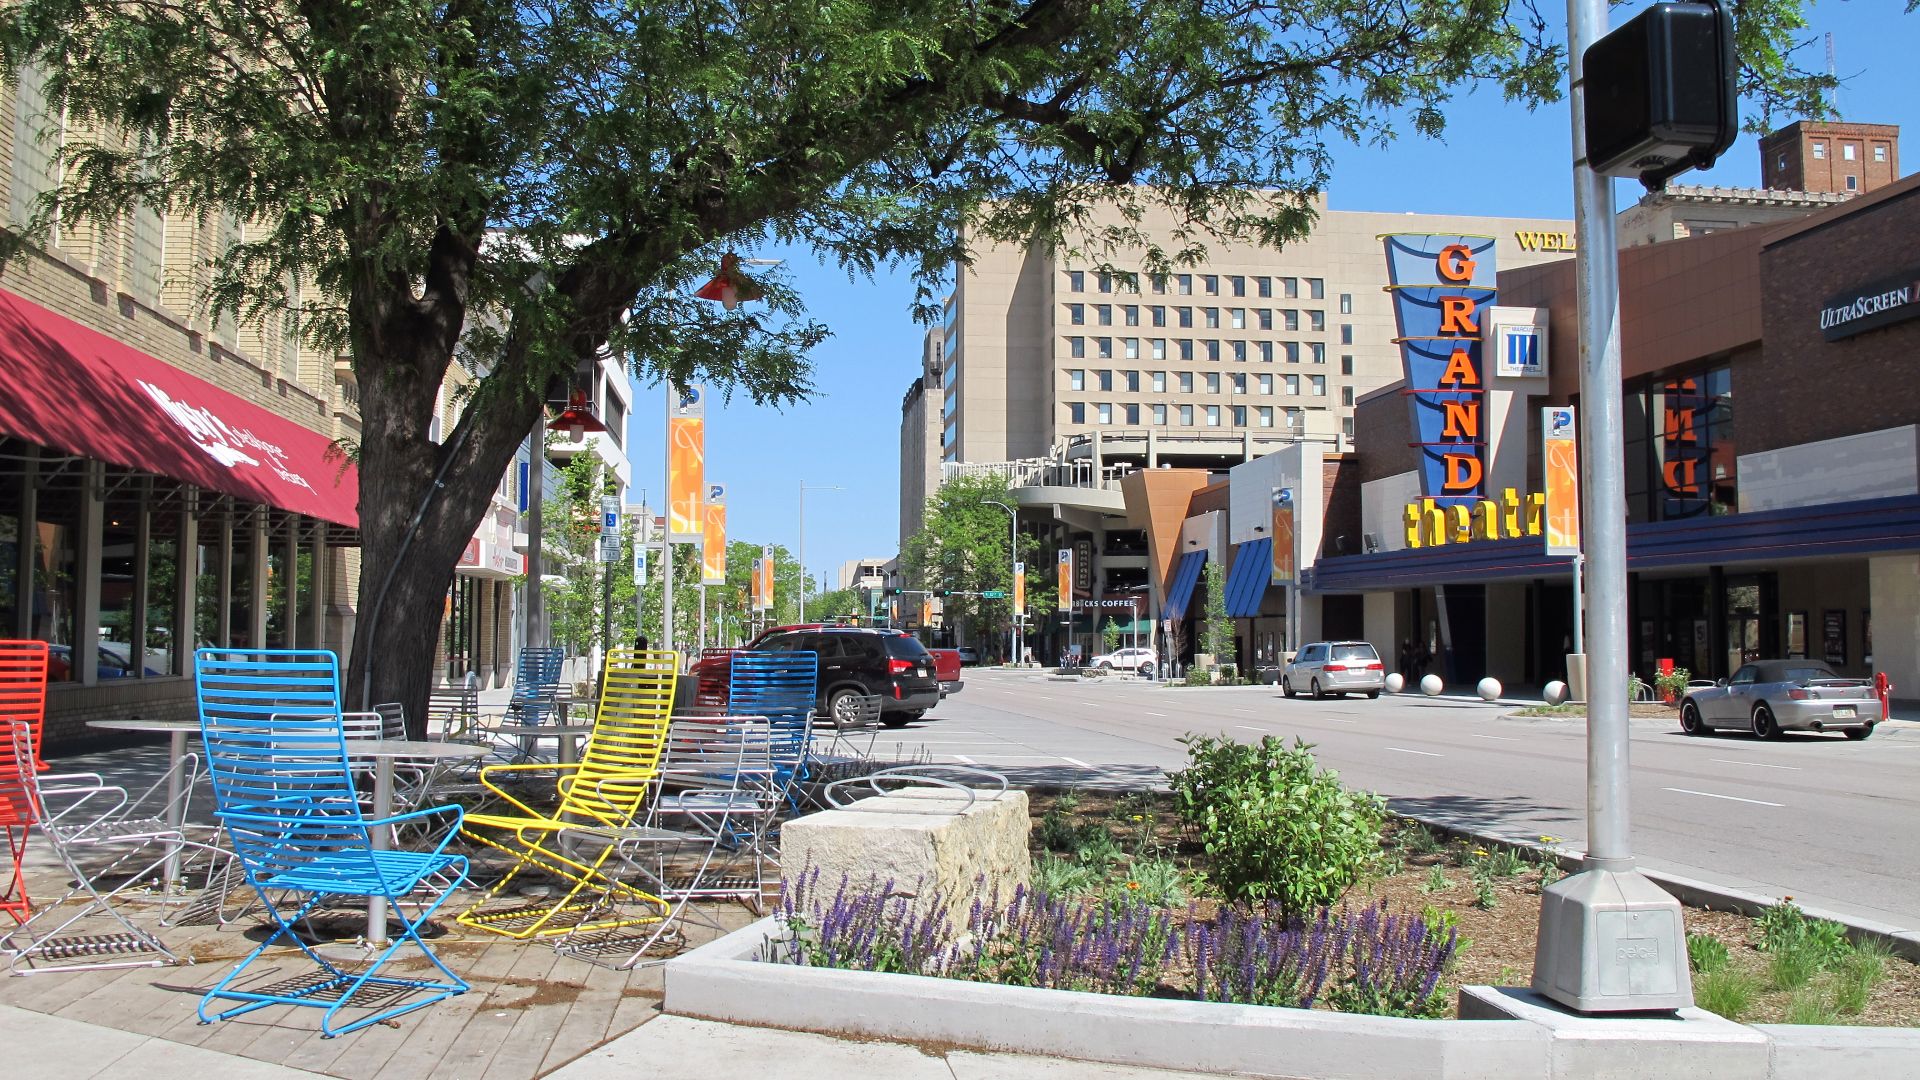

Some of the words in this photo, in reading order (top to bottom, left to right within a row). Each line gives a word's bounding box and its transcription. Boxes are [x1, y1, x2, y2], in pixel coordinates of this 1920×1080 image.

[1515, 231, 1576, 253] WEL
[1437, 244, 1482, 490] GRAND
[1402, 487, 1545, 548] theatr
